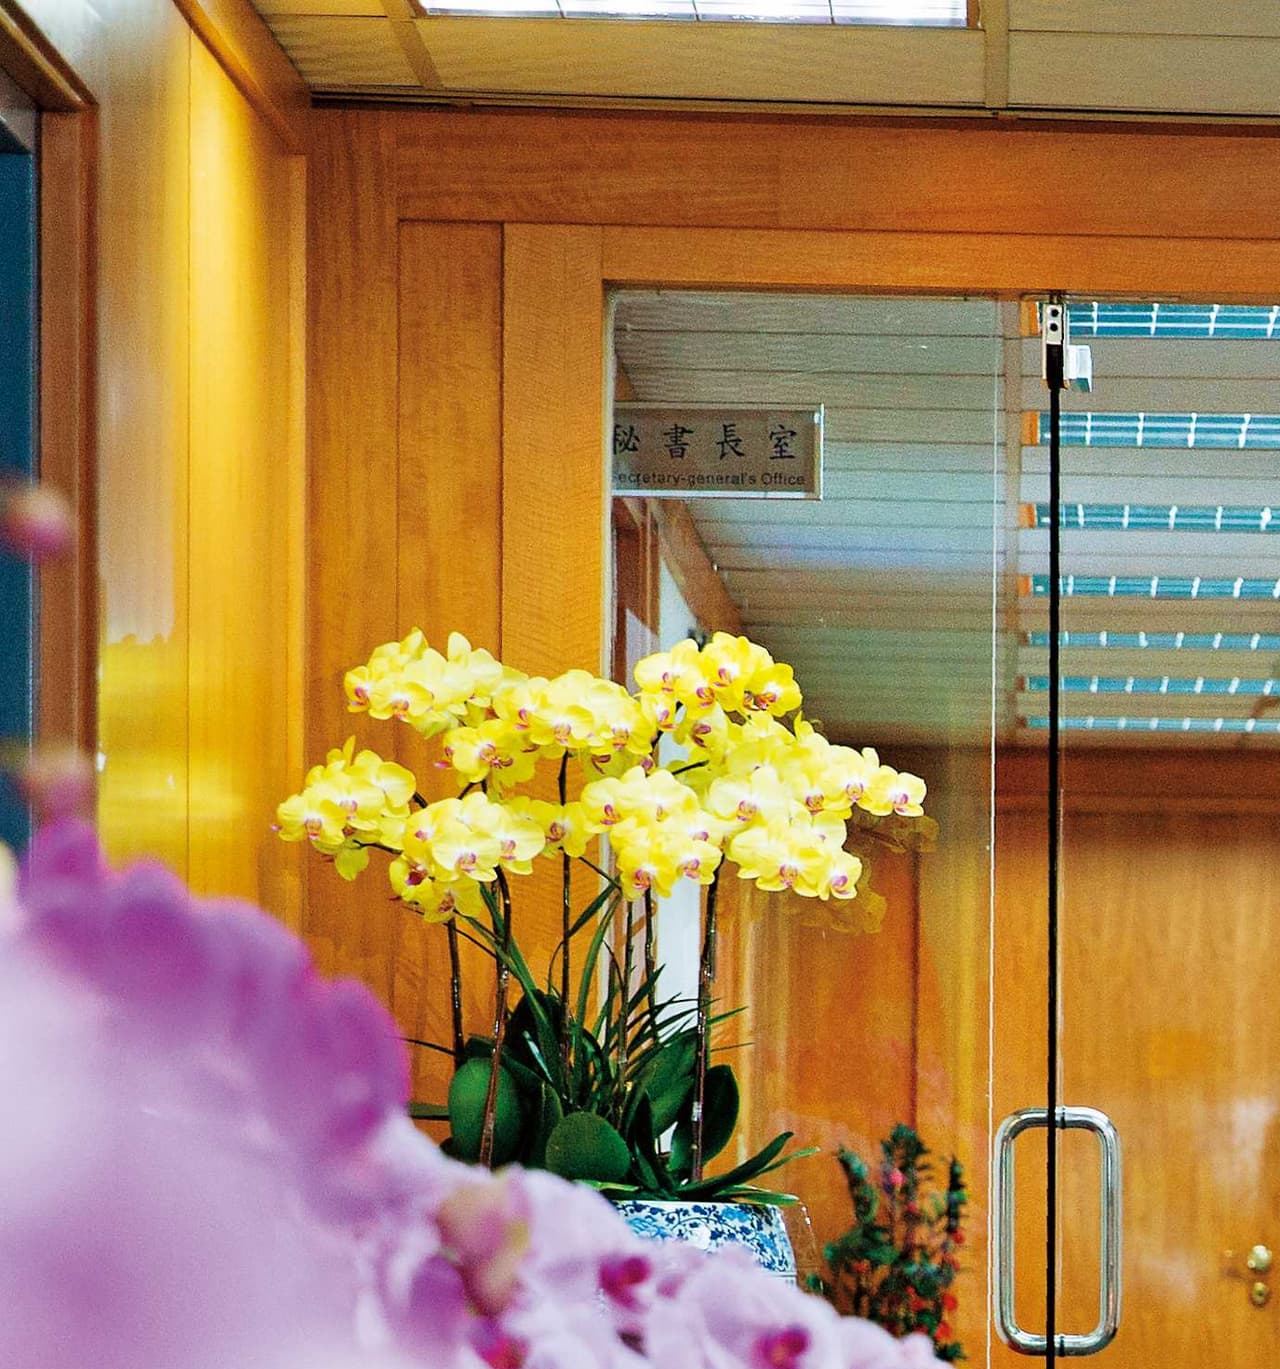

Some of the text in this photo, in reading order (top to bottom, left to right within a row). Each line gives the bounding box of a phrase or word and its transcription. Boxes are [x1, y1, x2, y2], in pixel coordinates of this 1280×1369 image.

[613, 423, 797, 460] 秘書長室
[761, 472, 805, 485] Office
